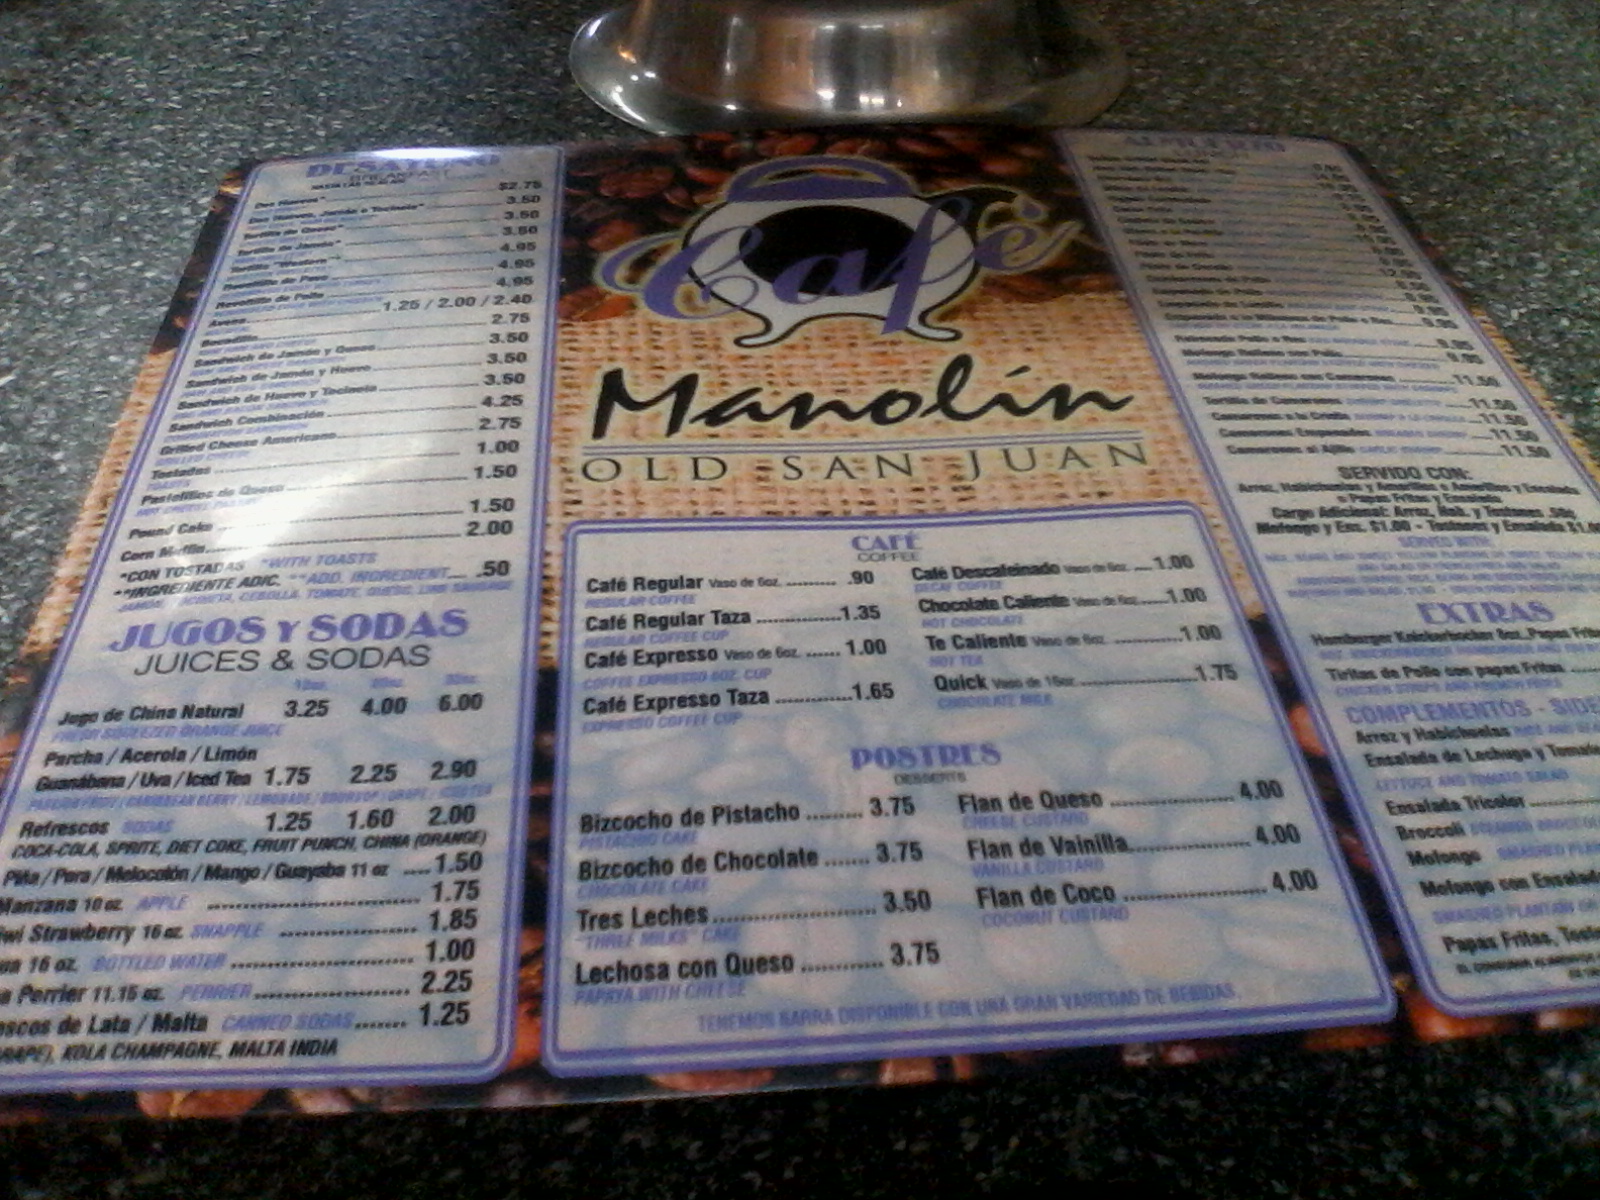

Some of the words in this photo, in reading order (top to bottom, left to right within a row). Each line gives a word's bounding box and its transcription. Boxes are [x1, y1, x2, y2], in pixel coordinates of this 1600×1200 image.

[601, 192, 1081, 335] Café
[383, 300, 420, 311] 1.25
[438, 297, 476, 308] 2.00
[493, 294, 532, 305] 2.40
[492, 313, 531, 324] 2.75
[489, 332, 529, 343] 3.50
[486, 352, 527, 364] 3.50
[483, 373, 525, 385] 3.50
[481, 394, 523, 407] 4.25
[591, 354, 1134, 440] Manolín
[479, 417, 522, 430] 2.75
[477, 440, 520, 454] 1.00
[473, 464, 518, 479] 1.50
[581, 455, 728, 483] OLD
[782, 452, 914, 481] SAN
[964, 442, 1148, 481] JUAN
[1338, 466, 1422, 480] SERVIDO
[469, 497, 515, 513] 1.50
[466, 521, 513, 536] 2.00
[476, 560, 509, 577] .50
[912, 567, 948, 580] Café
[1153, 555, 1195, 570] 1.00
[587, 577, 626, 594] Café
[633, 576, 704, 592] Regular
[847, 570, 874, 585] .90
[1167, 587, 1207, 603] 1.00
[586, 615, 626, 631] Café
[633, 612, 705, 631] Regular
[711, 610, 752, 625] Taza
[841, 605, 881, 621] 1.35
[1416, 601, 1555, 624] EXTRAS
[108, 614, 266, 652] JUGOS
[308, 608, 470, 642] SODAS
[926, 635, 947, 650] Te
[952, 634, 1028, 649] Caliente
[1180, 625, 1222, 641] 1.00
[134, 650, 259, 676] JUICES
[271, 648, 294, 671] &
[306, 644, 432, 671] SODAS
[585, 652, 627, 668] Café
[633, 648, 718, 667] Expresso
[845, 639, 887, 655] 1.00
[934, 675, 988, 691] Quick
[1195, 664, 1239, 682] 1.75
[103, 708, 123, 722] de
[181, 703, 245, 719] Natural
[284, 699, 329, 718] 3.25
[360, 696, 408, 715] 4.00
[439, 693, 483, 712] 6.00
[583, 697, 626, 715] Café
[633, 692, 721, 713] Expresso
[726, 689, 770, 705] Taza
[851, 682, 895, 700] 1.65
[120, 747, 186, 763] Acerola
[204, 745, 258, 762] Limón
[264, 766, 311, 786] 1.75
[350, 763, 398, 783] 2.25
[430, 760, 477, 780] 2.90
[958, 793, 1002, 814] Flan
[1009, 792, 1034, 810] de
[1039, 789, 1104, 810] Queso
[1239, 780, 1284, 800] 4.00
[19, 820, 110, 838] Refrescos
[266, 811, 312, 832] 1.25
[347, 808, 395, 830] 1.60
[428, 804, 476, 826] 2.00
[580, 812, 673, 834] Bizcocho
[680, 809, 705, 827] de
[712, 802, 800, 825] Pistacho
[869, 796, 915, 817] 3.75
[967, 838, 1012, 860] Flan
[1019, 837, 1045, 856] de
[1049, 833, 1129, 856] Vainilla
[1256, 824, 1301, 845] 4.00
[436, 851, 483, 873] 1.50
[578, 859, 673, 882] Bizcocho
[681, 854, 707, 874] de
[714, 848, 819, 872] Chocolate
[876, 841, 923, 864] 3.75
[432, 880, 481, 902] 1.75
[976, 886, 1024, 910] Flan
[1030, 884, 1057, 906] de
[1062, 883, 1116, 903] Coco
[1271, 869, 1318, 892] 4.00
[576, 909, 623, 931] Tres
[631, 904, 709, 927] Leches
[883, 889, 932, 914] 3.50
[29, 923, 136, 946] Strawberry
[429, 908, 478, 931] 1.85
[426, 938, 476, 962] 1.00
[576, 960, 669, 985] Lechosa
[677, 957, 718, 979] con
[725, 952, 795, 976] Queso
[890, 941, 941, 966] 3.75
[422, 970, 473, 994] 2.25
[420, 1001, 470, 1026] 1.25
